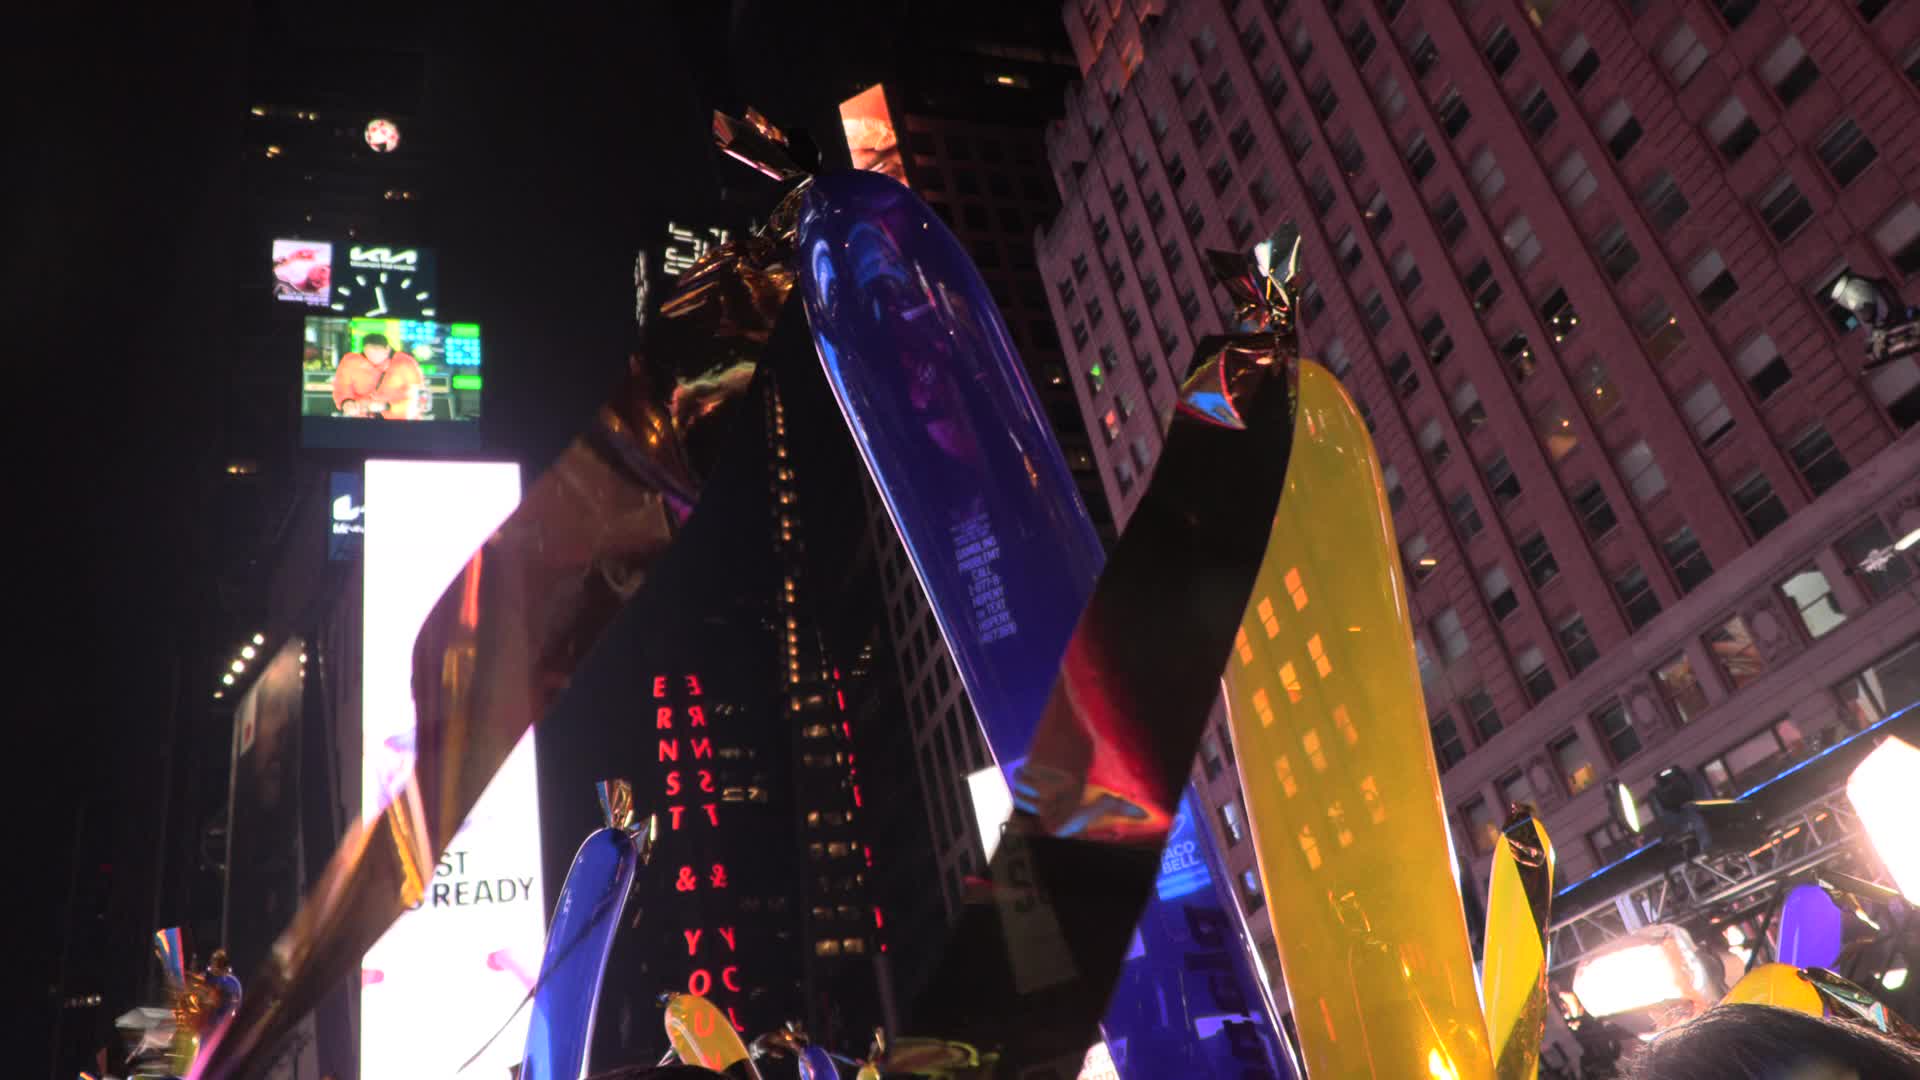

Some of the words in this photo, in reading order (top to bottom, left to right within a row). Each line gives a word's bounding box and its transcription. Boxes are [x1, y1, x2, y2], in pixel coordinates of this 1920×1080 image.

[653, 676, 685, 829] ERNST
[676, 866, 696, 891] &
[1163, 840, 1196, 859] ACO
[1163, 854, 1200, 874] BELL
[432, 877, 533, 908] READY
